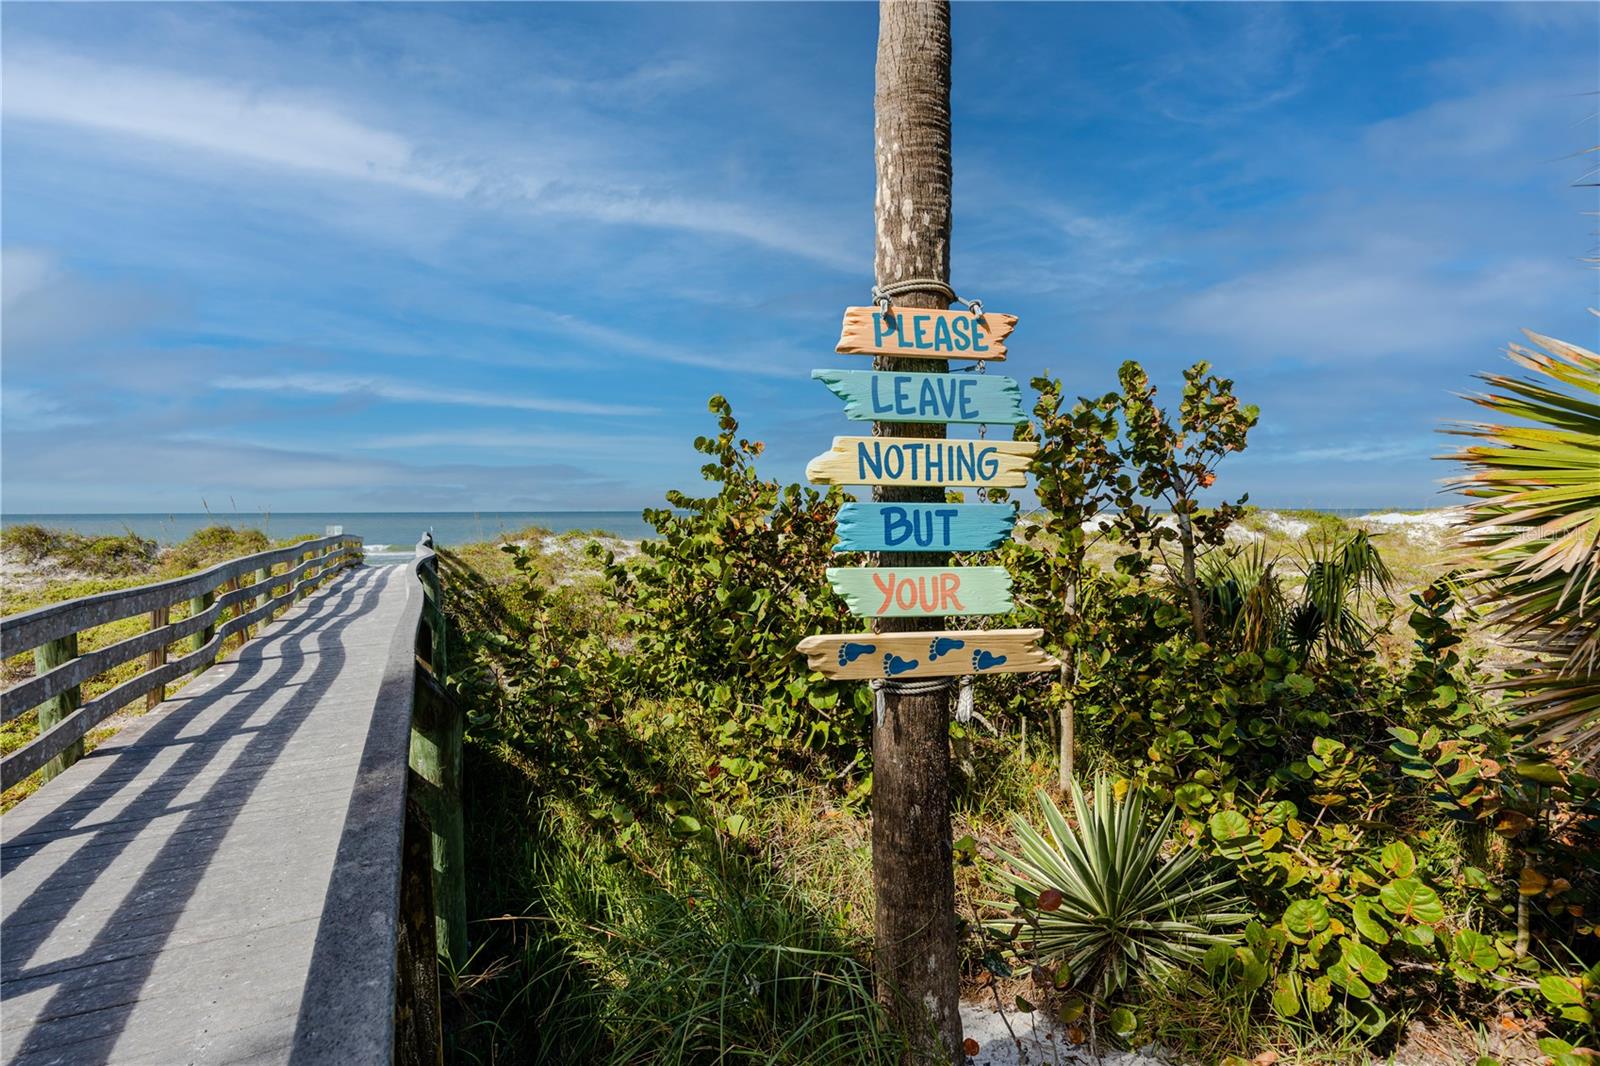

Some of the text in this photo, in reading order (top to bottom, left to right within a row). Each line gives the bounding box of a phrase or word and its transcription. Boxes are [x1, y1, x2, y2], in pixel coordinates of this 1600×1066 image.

[872, 312, 989, 351] PLEASE
[872, 375, 979, 419] LEAVE
[858, 441, 999, 482] NOTHING
[880, 506, 958, 547] BUT
[872, 572, 966, 615] YOUR
